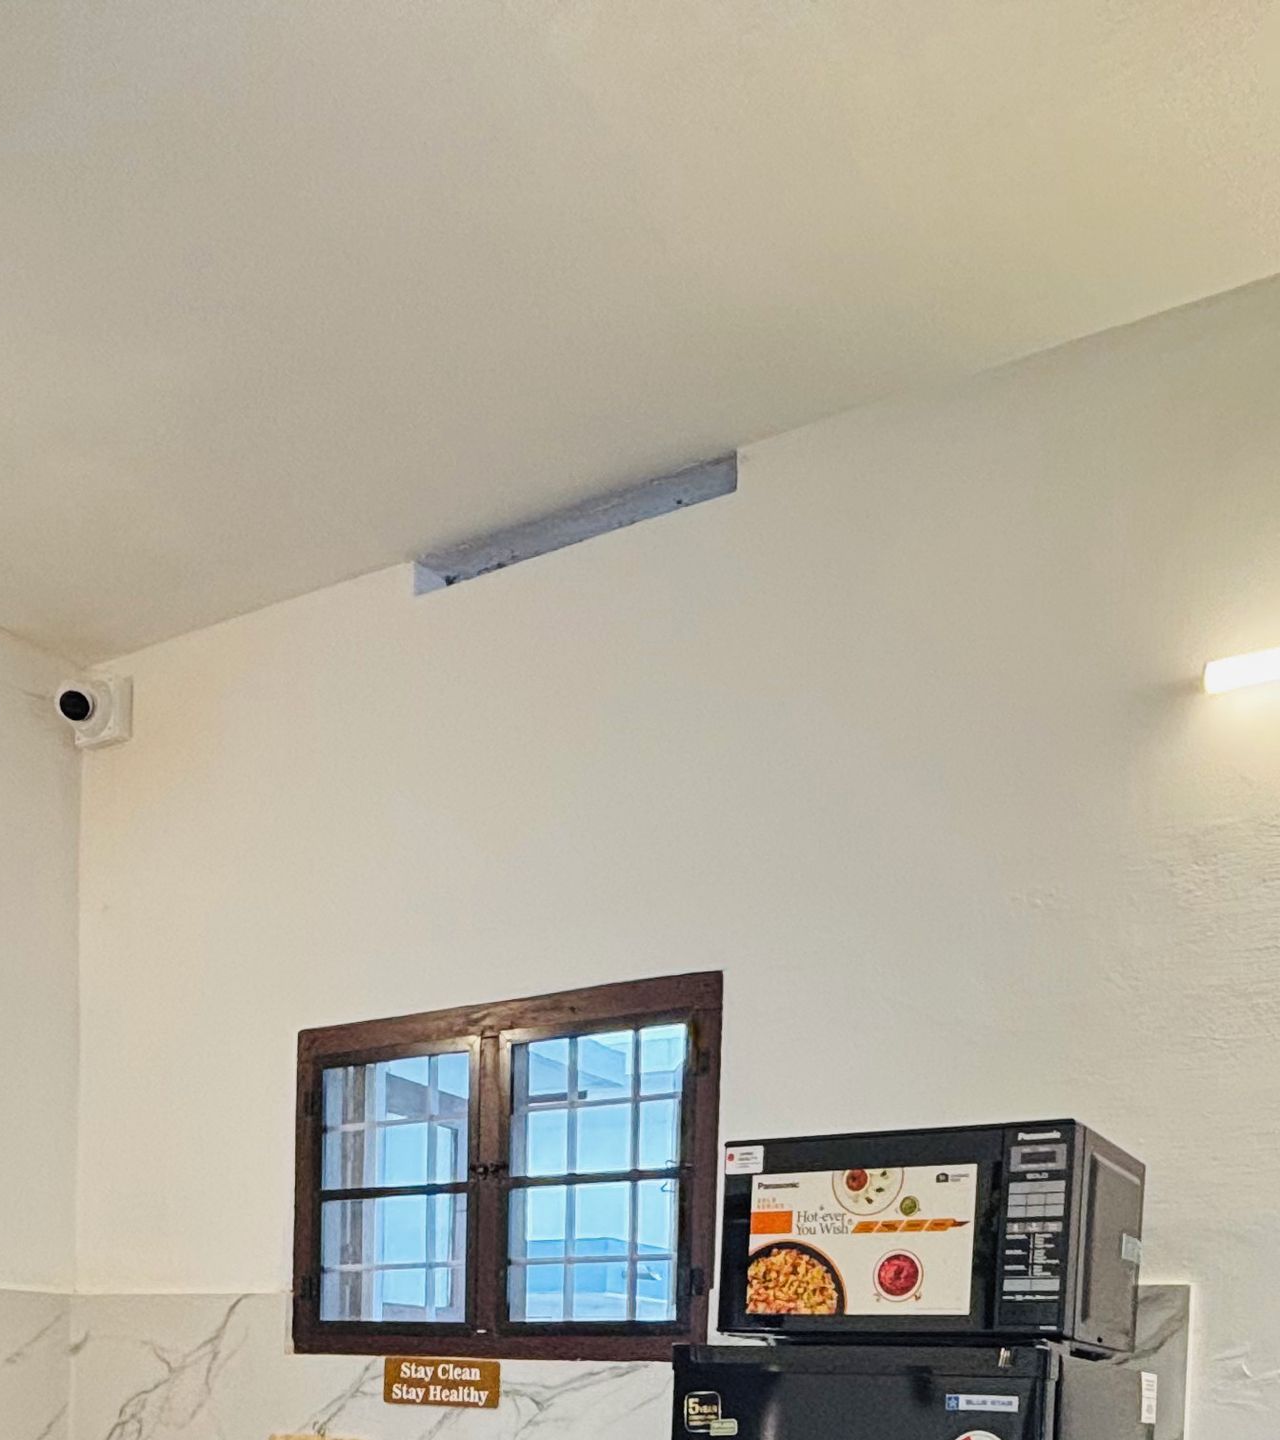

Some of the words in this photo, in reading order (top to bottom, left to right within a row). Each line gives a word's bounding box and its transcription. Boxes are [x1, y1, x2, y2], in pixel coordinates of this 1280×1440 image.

[796, 1223, 817, 1236] You
[819, 1223, 849, 1235] Wish
[400, 1361, 435, 1382] Stay
[437, 1363, 481, 1381] Clean
[392, 1383, 426, 1403] Stay
[428, 1385, 489, 1406] Healthy
[688, 1398, 700, 1414] 5
